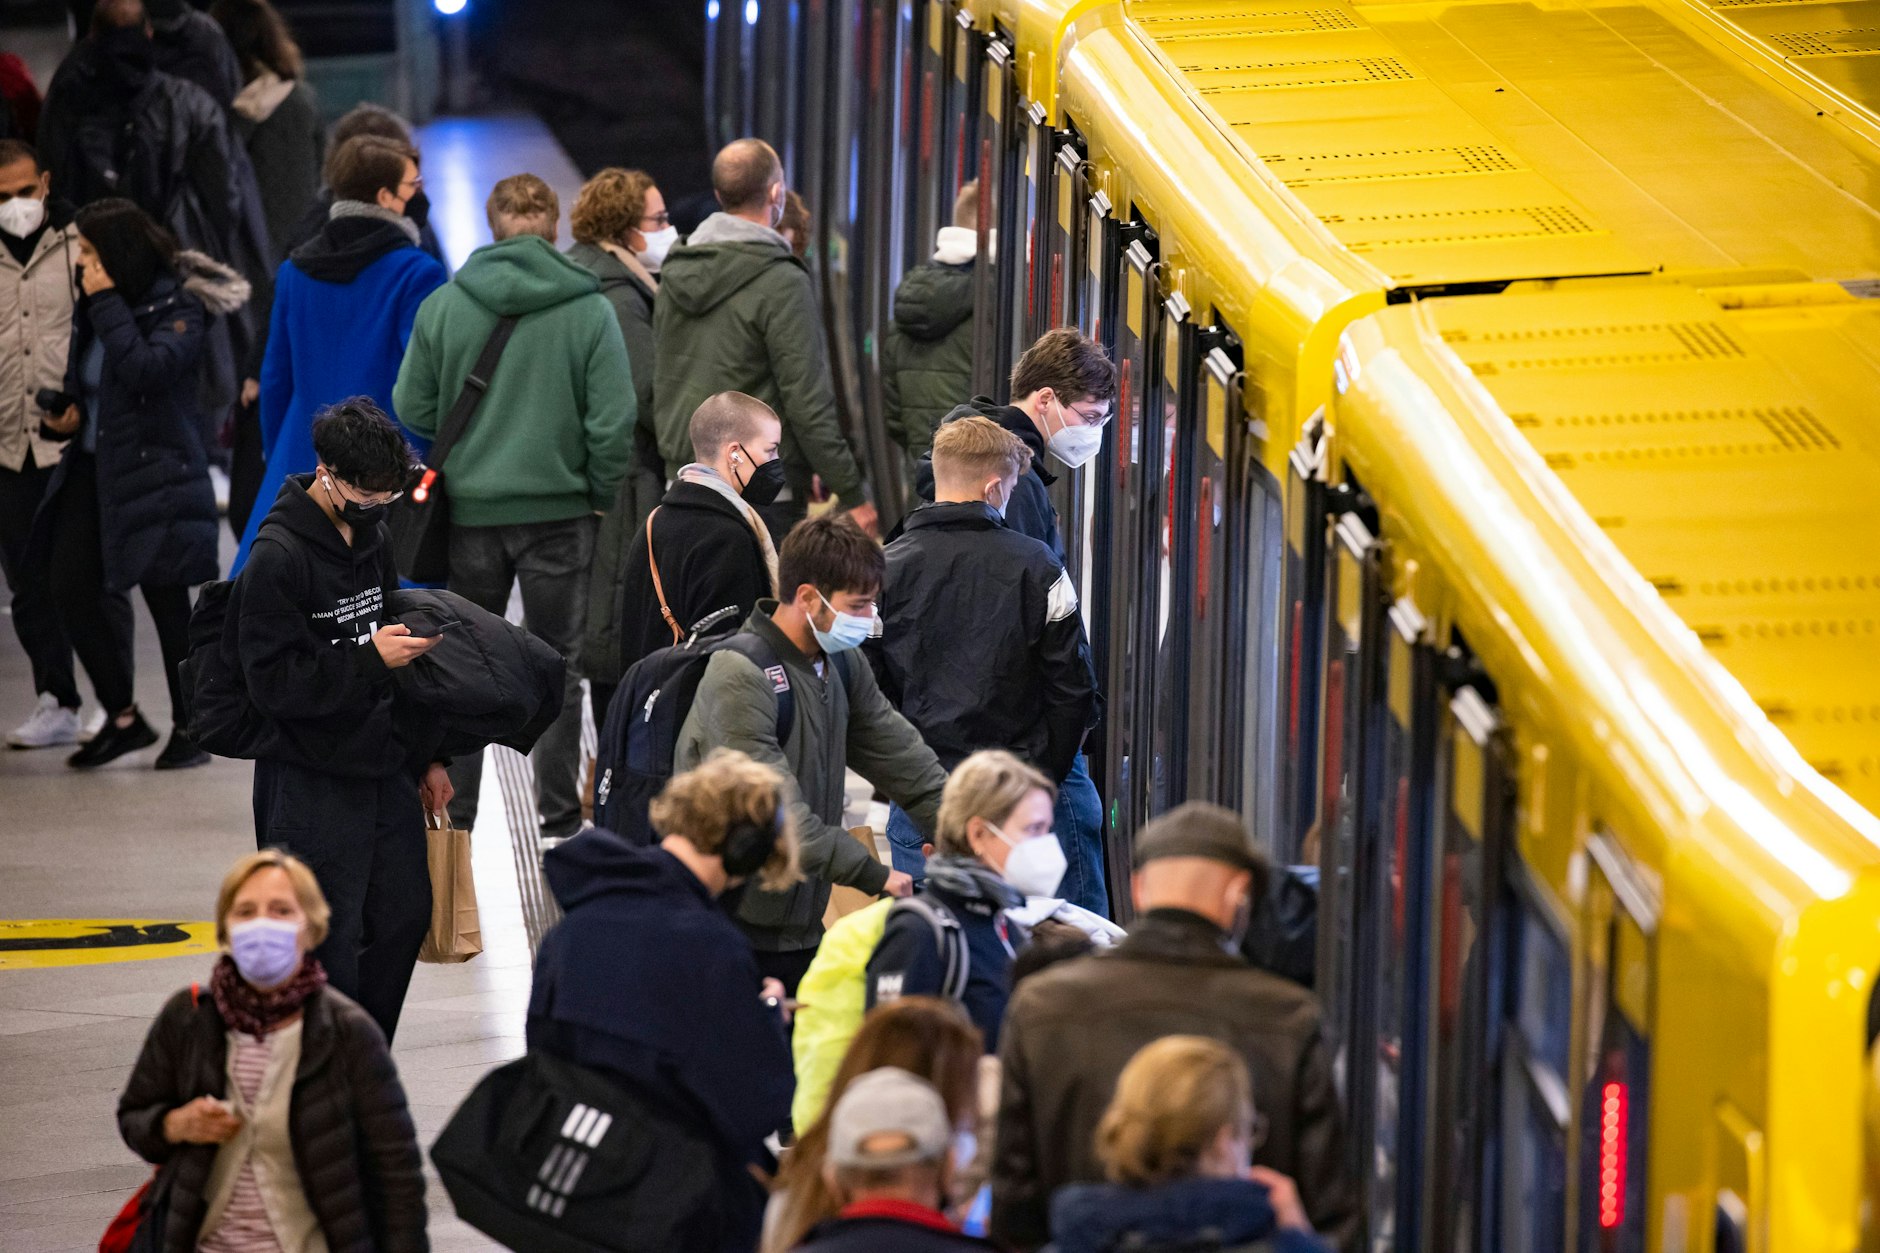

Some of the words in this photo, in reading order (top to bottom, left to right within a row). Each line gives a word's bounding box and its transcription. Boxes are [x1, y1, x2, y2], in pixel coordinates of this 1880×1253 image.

[364, 586, 381, 596] BECO
[361, 598, 372, 607] BUT
[337, 612, 355, 623] BECOME
[359, 607, 371, 616] MAN
[371, 604, 378, 612] OF
